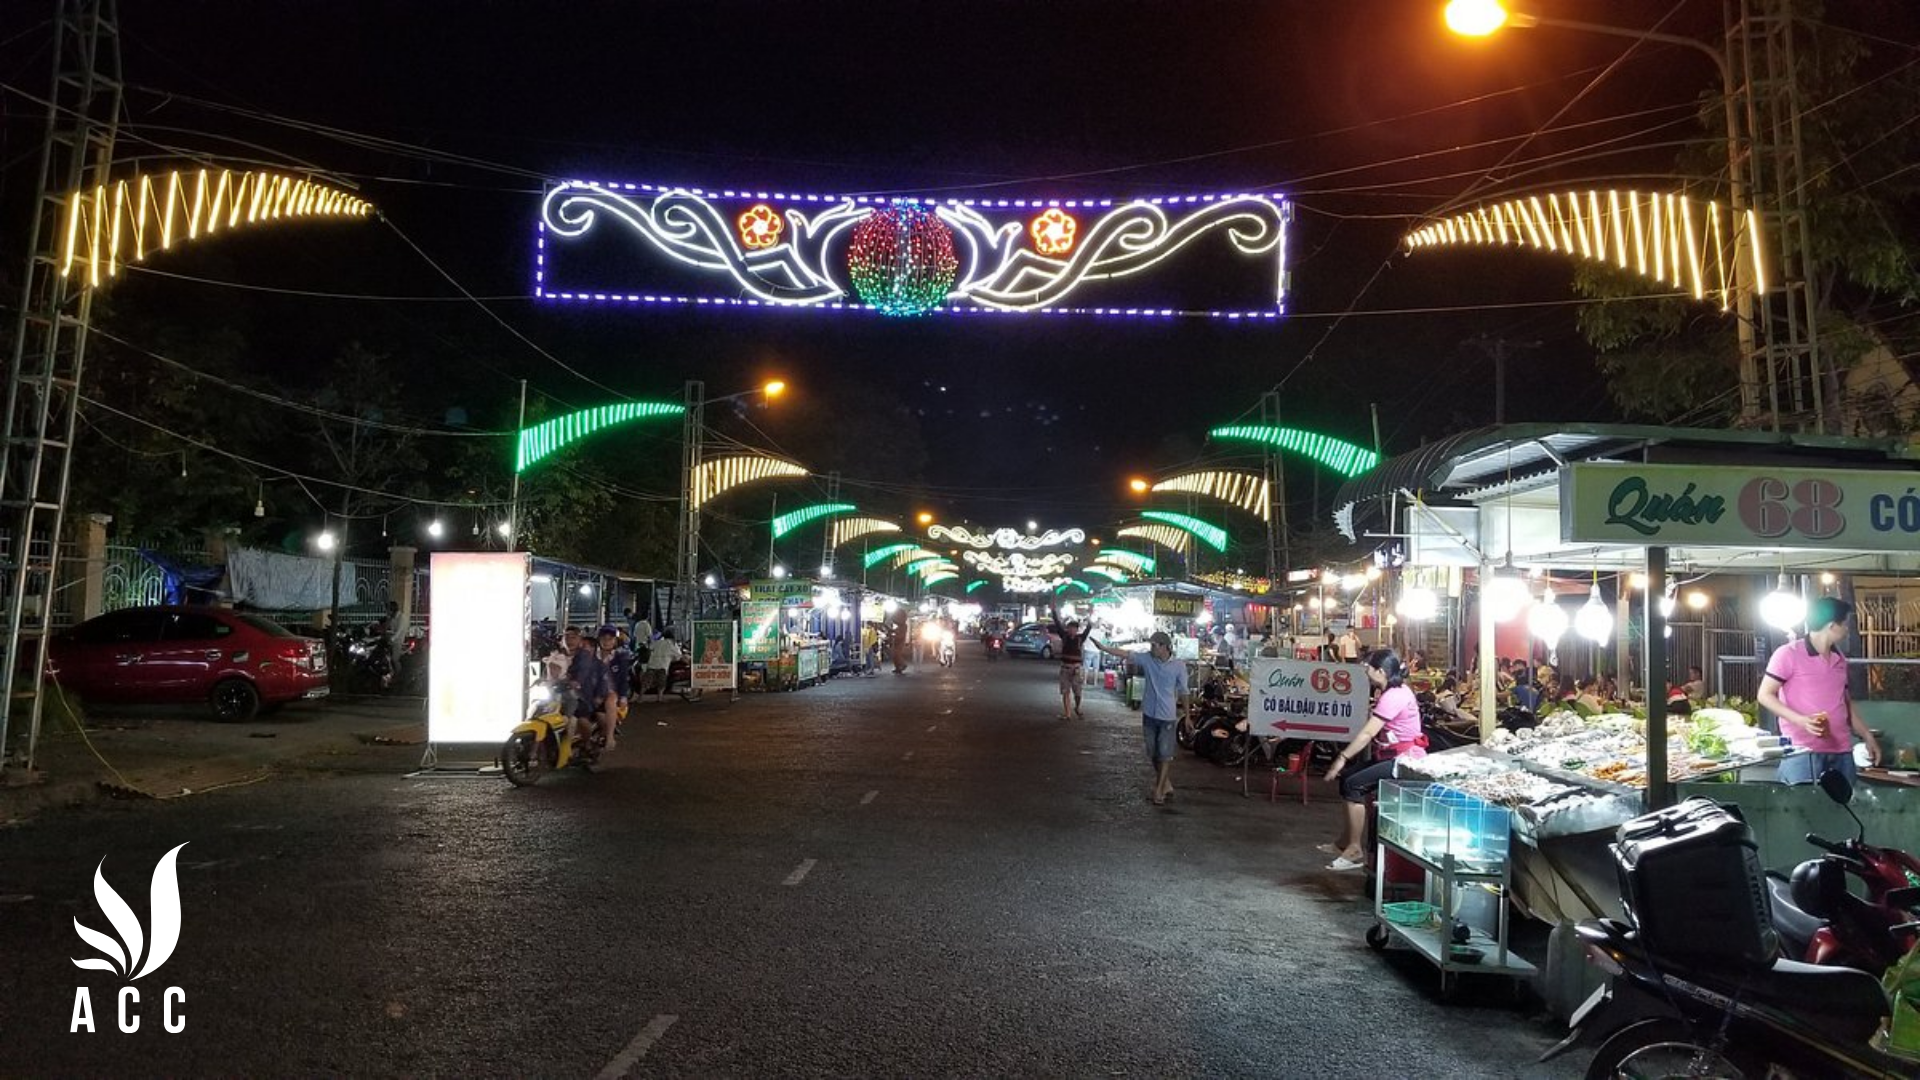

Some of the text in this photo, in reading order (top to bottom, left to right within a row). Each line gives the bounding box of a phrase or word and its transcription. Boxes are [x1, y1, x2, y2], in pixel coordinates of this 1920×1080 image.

[1605, 476, 1920, 540] Quán 68 CÓ
[1268, 668, 1352, 695] Quán 68
[1317, 702, 1329, 716] XE
